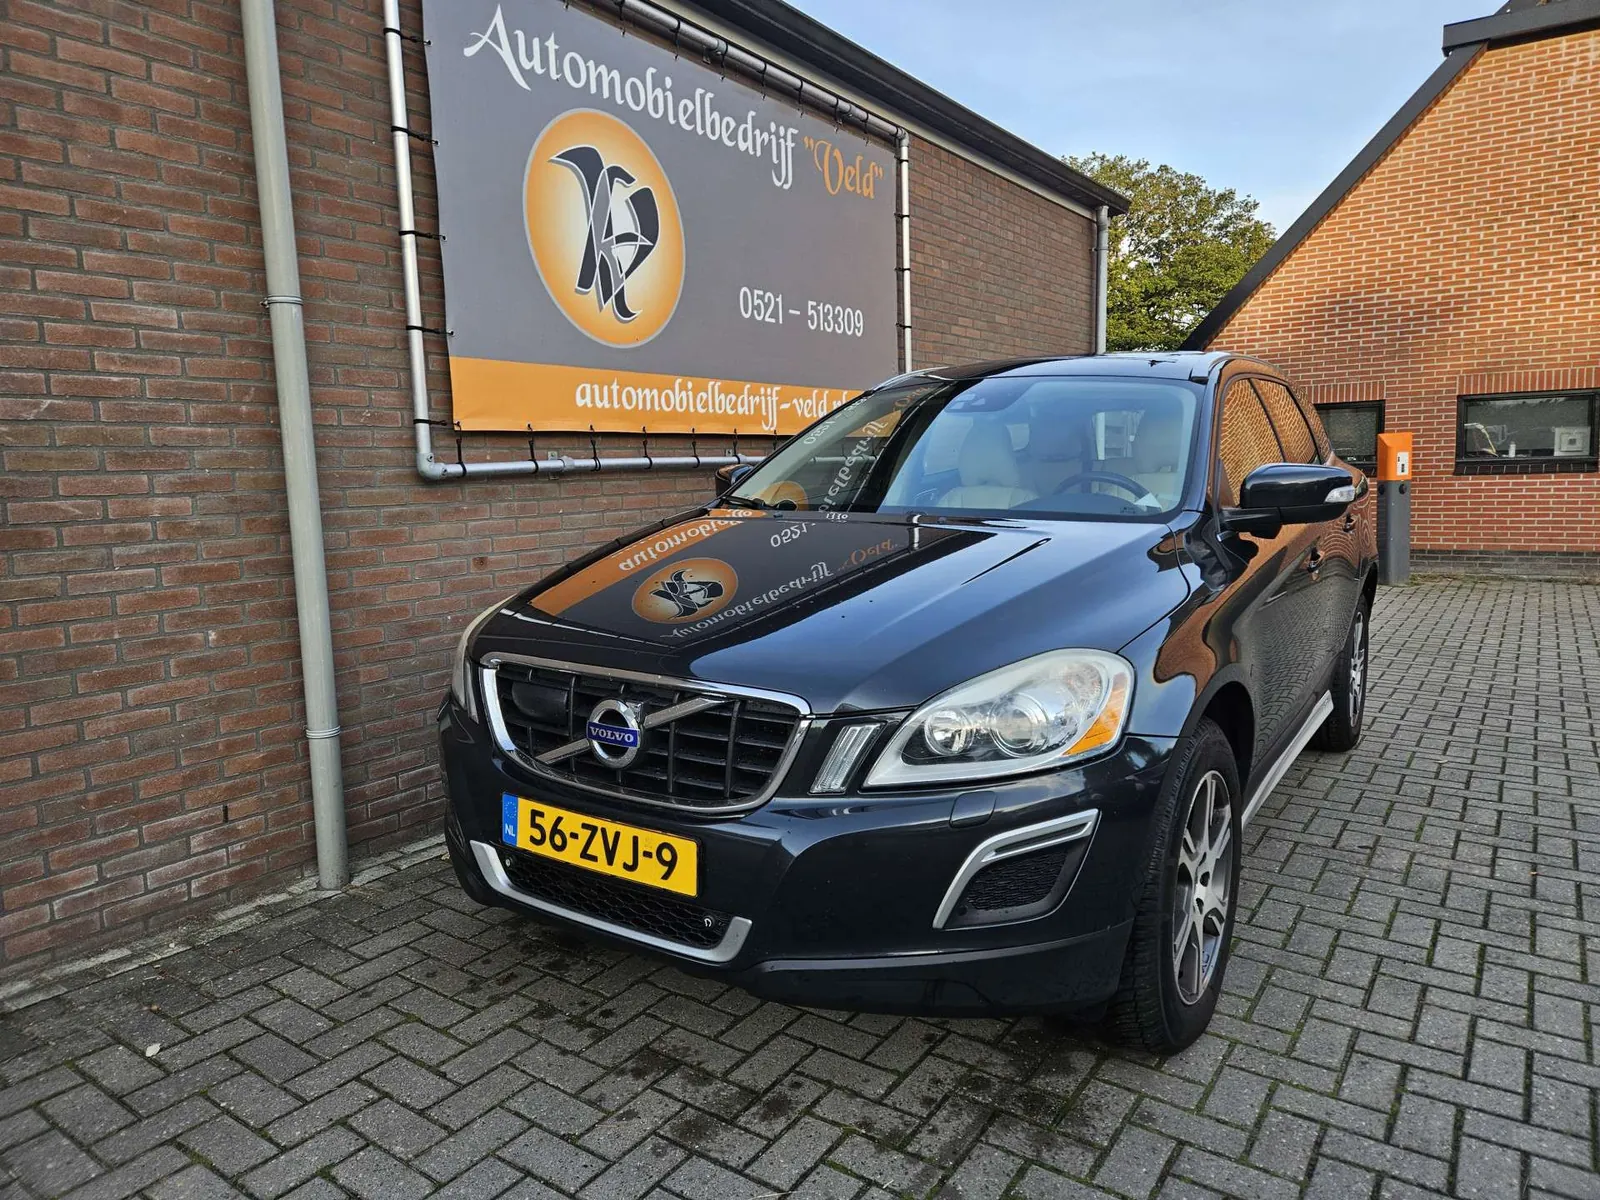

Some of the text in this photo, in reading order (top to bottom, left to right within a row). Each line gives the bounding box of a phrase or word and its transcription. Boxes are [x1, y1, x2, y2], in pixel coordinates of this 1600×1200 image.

[463, 4, 799, 190] Automobielbedrijf
[739, 286, 783, 325] 0521
[807, 300, 864, 338] 513309
[590, 726, 634, 743] VOLVO
[504, 823, 516, 838] NL
[529, 809, 678, 881] 56-ZVJ-9
